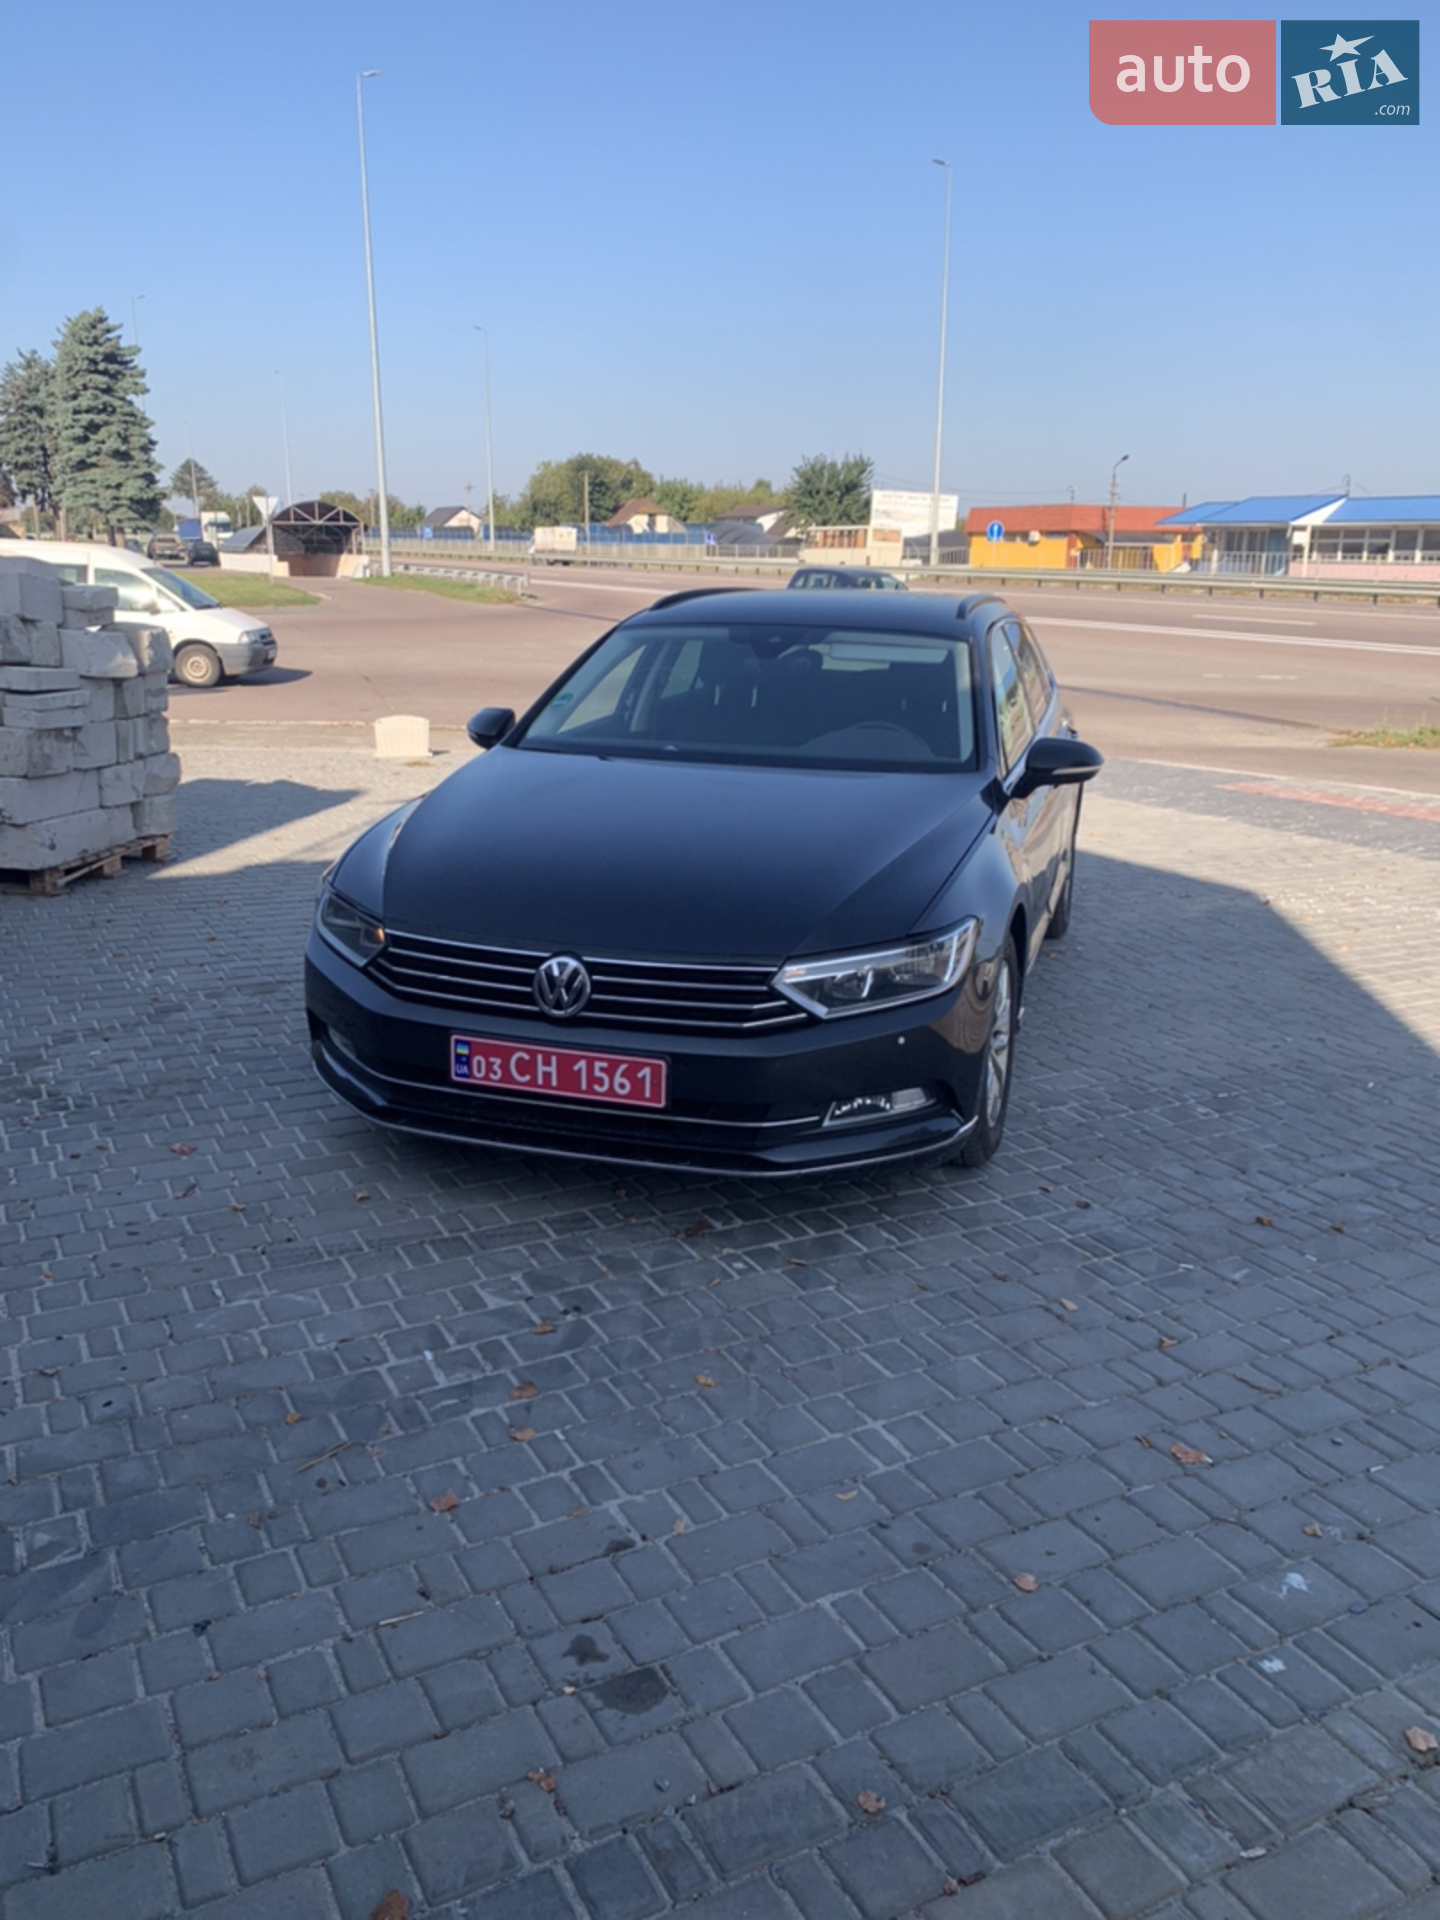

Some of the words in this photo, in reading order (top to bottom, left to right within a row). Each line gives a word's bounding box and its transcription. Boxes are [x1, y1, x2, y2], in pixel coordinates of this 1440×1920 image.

[472, 1055, 503, 1080] 03
[509, 1051, 558, 1087] CH
[572, 1059, 652, 1098] 1561
